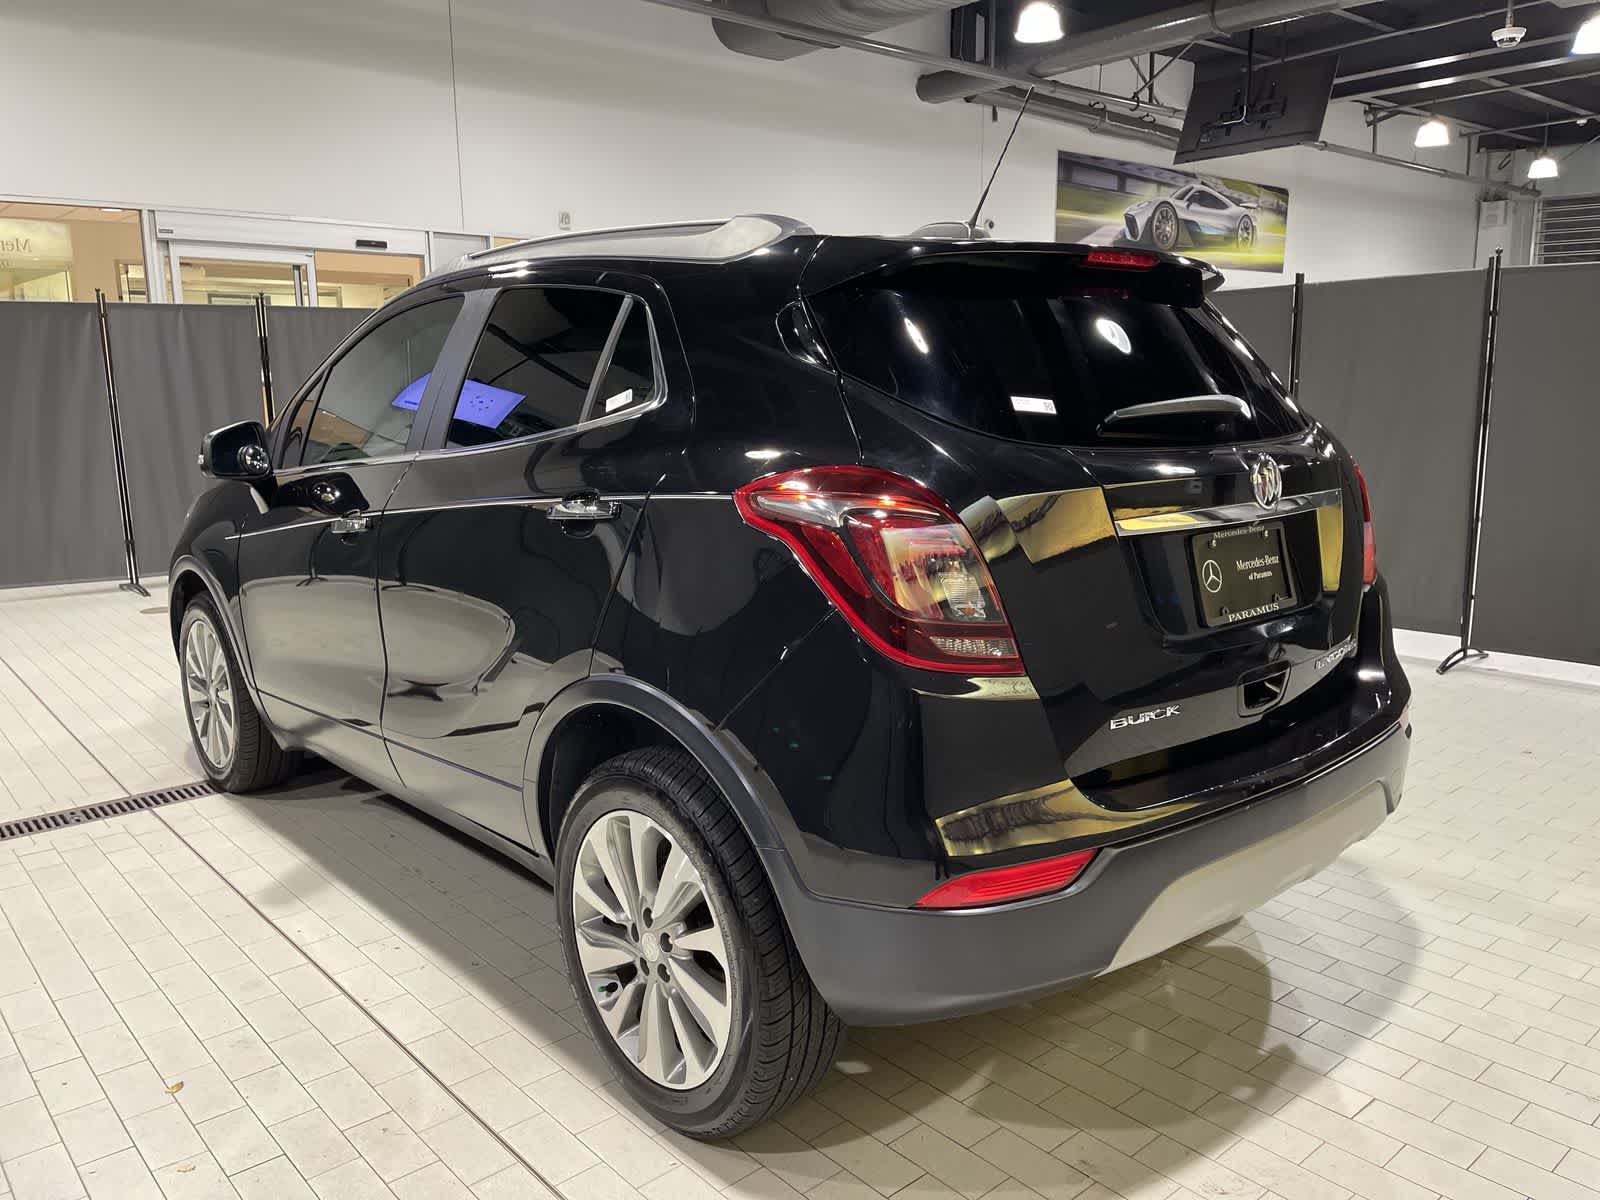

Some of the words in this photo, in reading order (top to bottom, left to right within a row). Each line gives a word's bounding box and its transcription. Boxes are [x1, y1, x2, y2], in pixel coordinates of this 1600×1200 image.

[1236, 555, 1279, 570] Mercedes-Benz
[1254, 571, 1272, 579] Paramus
[1228, 602, 1280, 622] PARAMUS
[1110, 705, 1180, 730] BUICK
